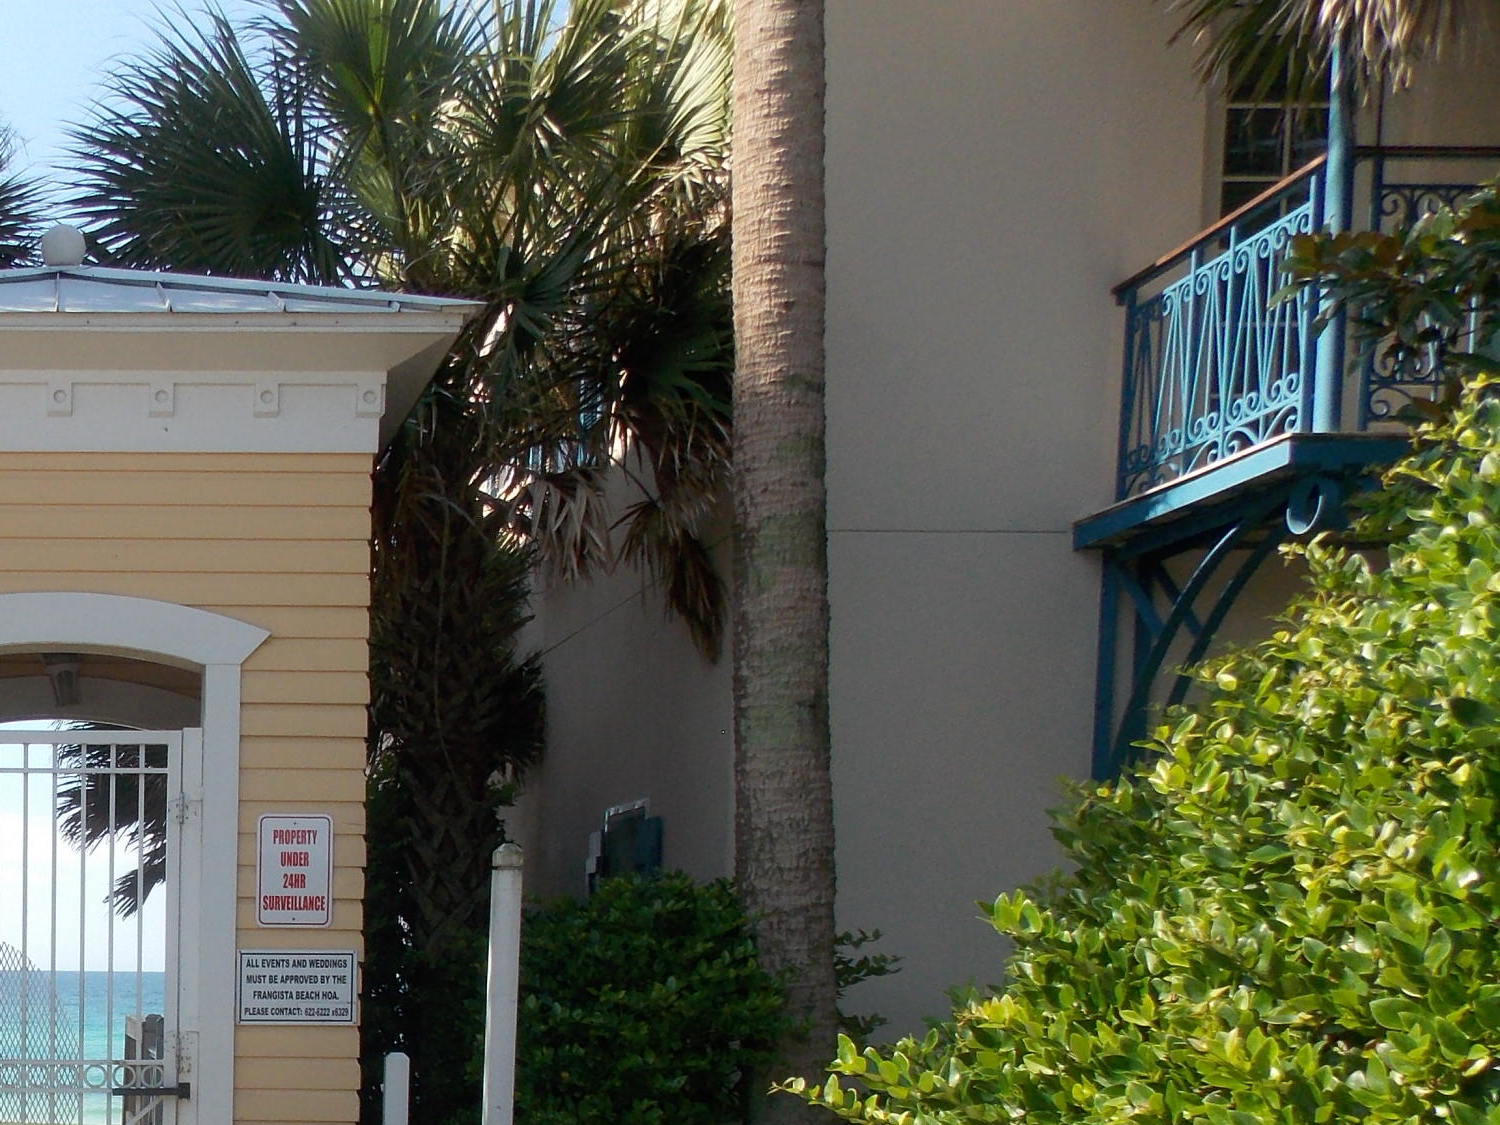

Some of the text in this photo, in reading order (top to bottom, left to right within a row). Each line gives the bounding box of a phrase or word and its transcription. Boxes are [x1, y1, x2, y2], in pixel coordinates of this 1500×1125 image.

[273, 829, 318, 845] PROPERTY
[280, 851, 309, 867] UNDER
[283, 873, 306, 888] 24HR
[263, 895, 325, 911] SURVEILLANCE
[246, 959, 347, 968] ALL EVENTS AND WEDDINGS
[246, 975, 347, 984] MUST BE APPROVED BY THE
[253, 990, 340, 1000] FRANGISTA BEACH HOA.
[244, 1007, 269, 1016] PLEASE
[270, 1007, 303, 1016] CONTACT:
